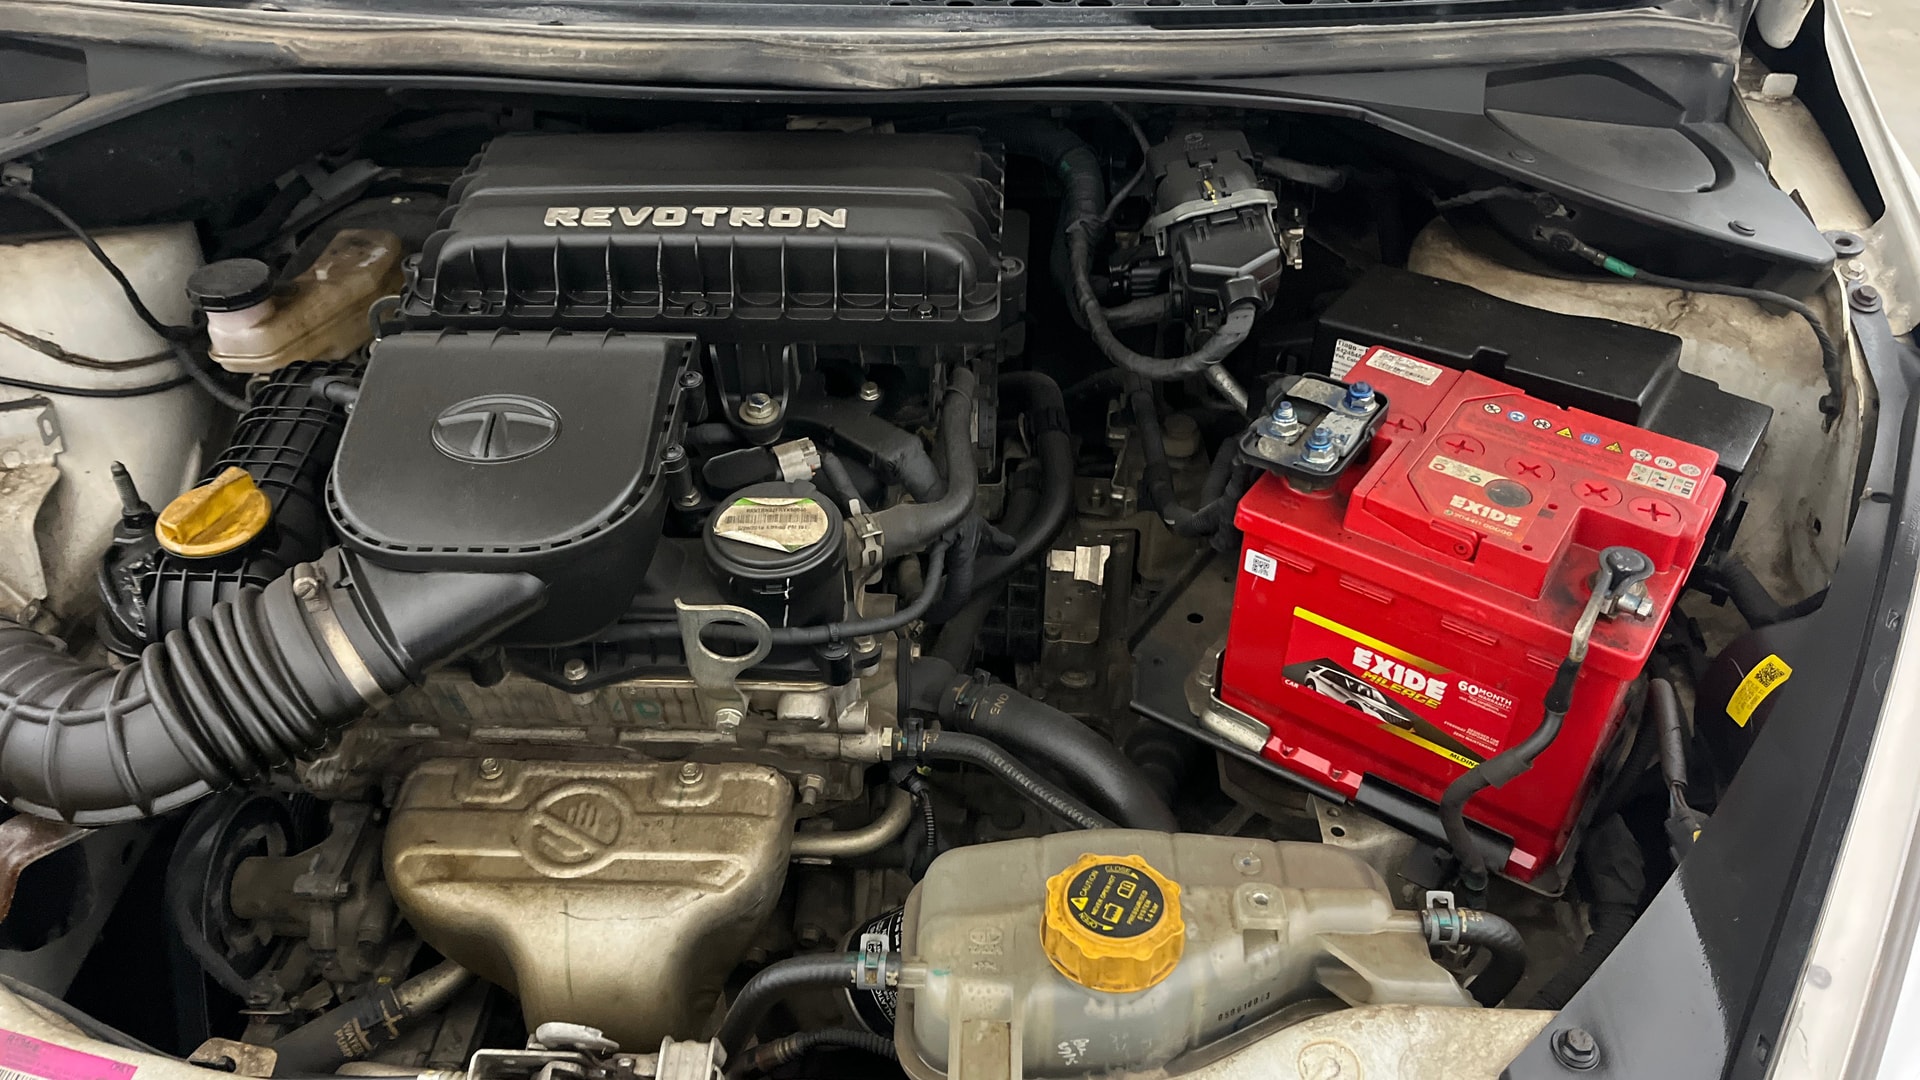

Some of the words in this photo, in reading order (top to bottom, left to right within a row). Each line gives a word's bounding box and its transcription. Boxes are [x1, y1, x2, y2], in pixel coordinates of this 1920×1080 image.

[544, 206, 847, 229] REVOTRON
[1449, 494, 1522, 527] EXIDE
[1284, 678, 1299, 689] CAR
[1352, 646, 1448, 702] EXIDE
[1361, 671, 1442, 709] MILEAGE
[1458, 680, 1479, 696] 60
[1479, 687, 1512, 706] MONTH
[989, 693, 1009, 715] END
[1105, 865, 1132, 876] CLOSE
[1080, 870, 1098, 896] CAUTION
[1078, 911, 1098, 929] OPEN
